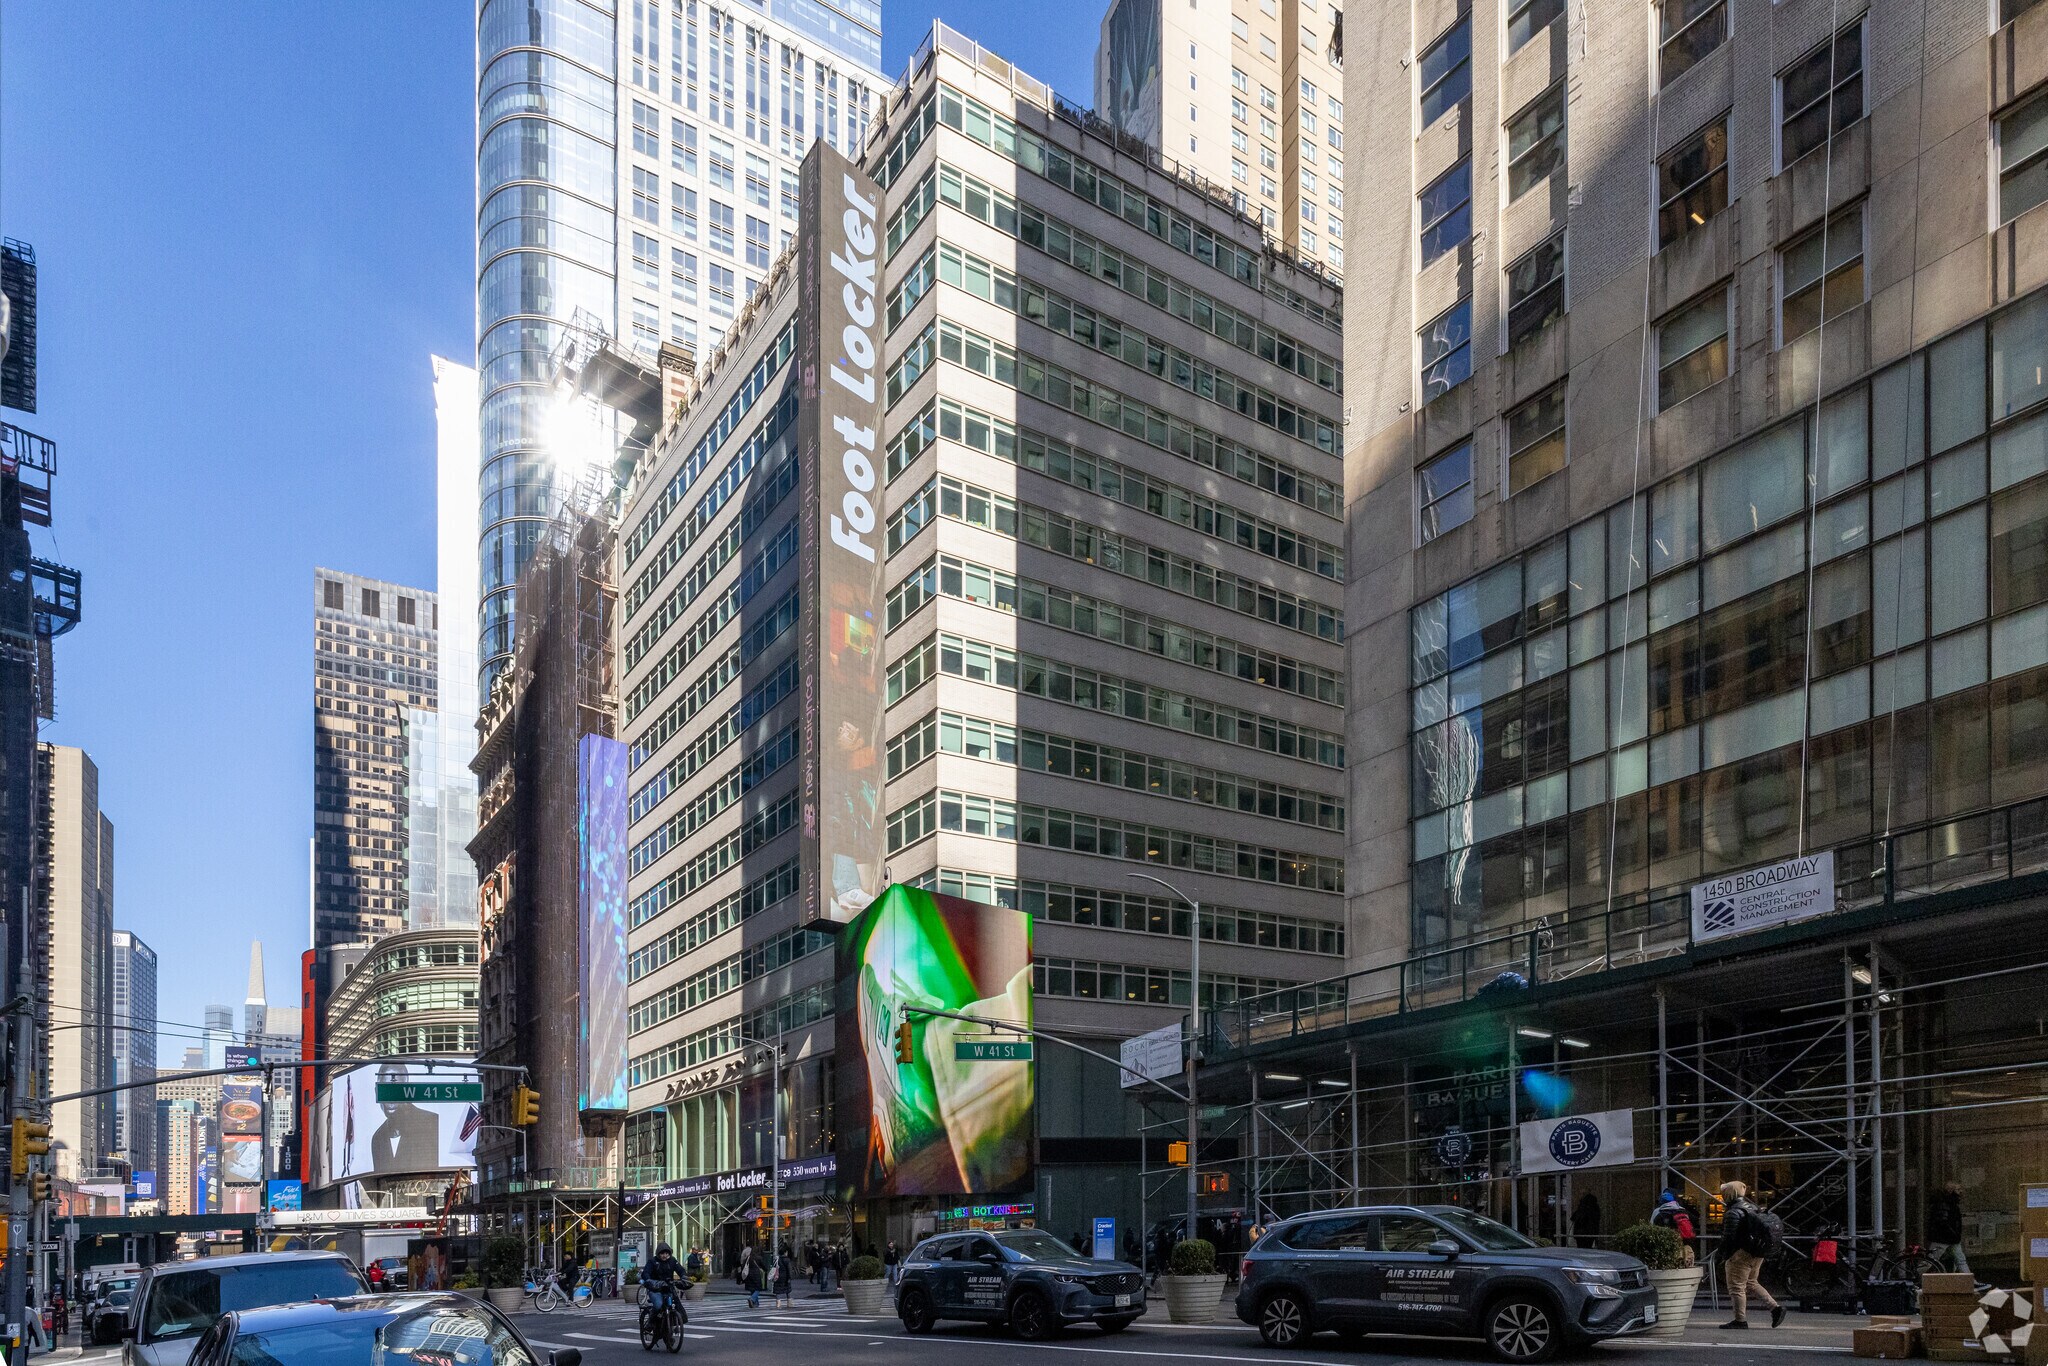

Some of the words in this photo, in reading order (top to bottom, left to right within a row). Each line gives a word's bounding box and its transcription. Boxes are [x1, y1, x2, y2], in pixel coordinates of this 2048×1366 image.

[830, 173, 876, 404] Locker
[830, 414, 876, 564] Foot
[804, 674, 814, 755] balance
[804, 759, 814, 797] new
[1703, 879, 1732, 899] 1450
[1736, 857, 1819, 891] BROADWAY
[1740, 889, 1785, 905] CENTRAL
[1740, 888, 1820, 913] CONSTRUCTION
[1740, 898, 1815, 921] MANAGEMENT
[974, 1046, 984, 1057] W
[989, 1046, 1000, 1057] 41
[1004, 1046, 1015, 1057] St
[403, 1086, 416, 1099] W
[423, 1086, 438, 1099] 41
[444, 1086, 458, 1099] St
[1551, 1123, 1567, 1141] PARIS
[1567, 1119, 1598, 1136] BAGUETTE
[792, 1165, 804, 1177] 550
[804, 1165, 819, 1175] worn
[820, 1162, 828, 1176] by
[1555, 1154, 1580, 1166] BAKERY
[717, 1176, 736, 1191] Foot
[736, 1170, 766, 1188] Locker
[296, 1213, 323, 1222] H&M
[345, 1210, 377, 1220] TIMES
[379, 1209, 421, 1220] SQUARE
[978, 1276, 1002, 1284] STREAM
[1385, 1269, 1405, 1278] AIR
[1407, 1269, 1456, 1279] STREAM
